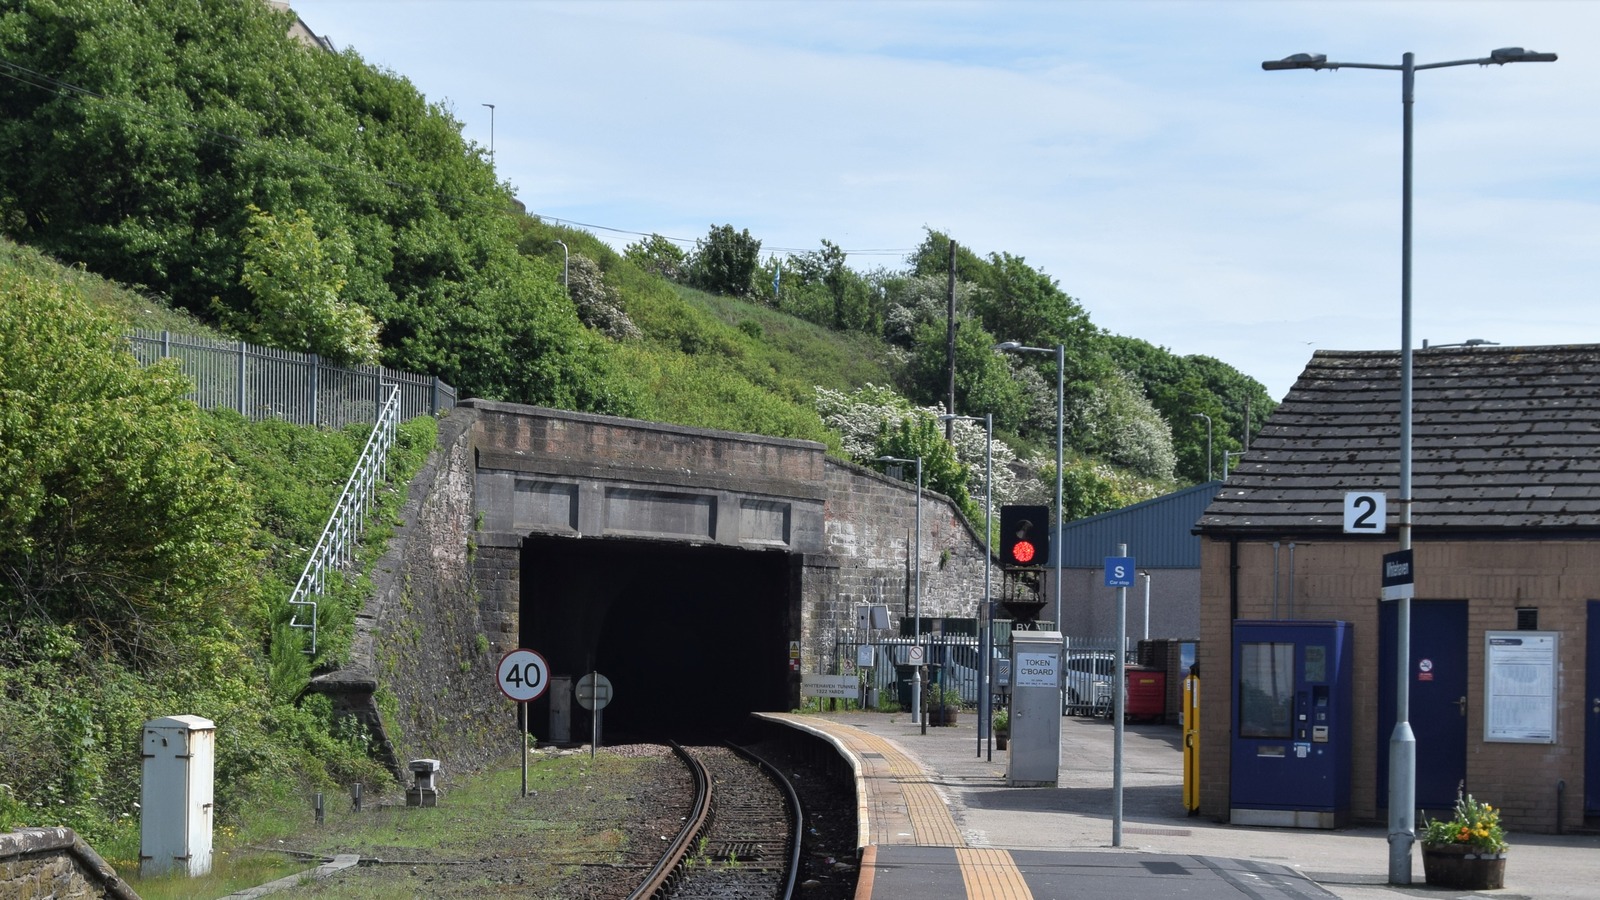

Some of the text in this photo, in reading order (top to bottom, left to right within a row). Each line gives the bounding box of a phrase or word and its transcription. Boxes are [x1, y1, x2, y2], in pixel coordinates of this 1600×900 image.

[1352, 495, 1377, 529] 2
[1114, 566, 1124, 578] S
[1386, 561, 1409, 578] Whitehaven
[505, 662, 541, 688] 40
